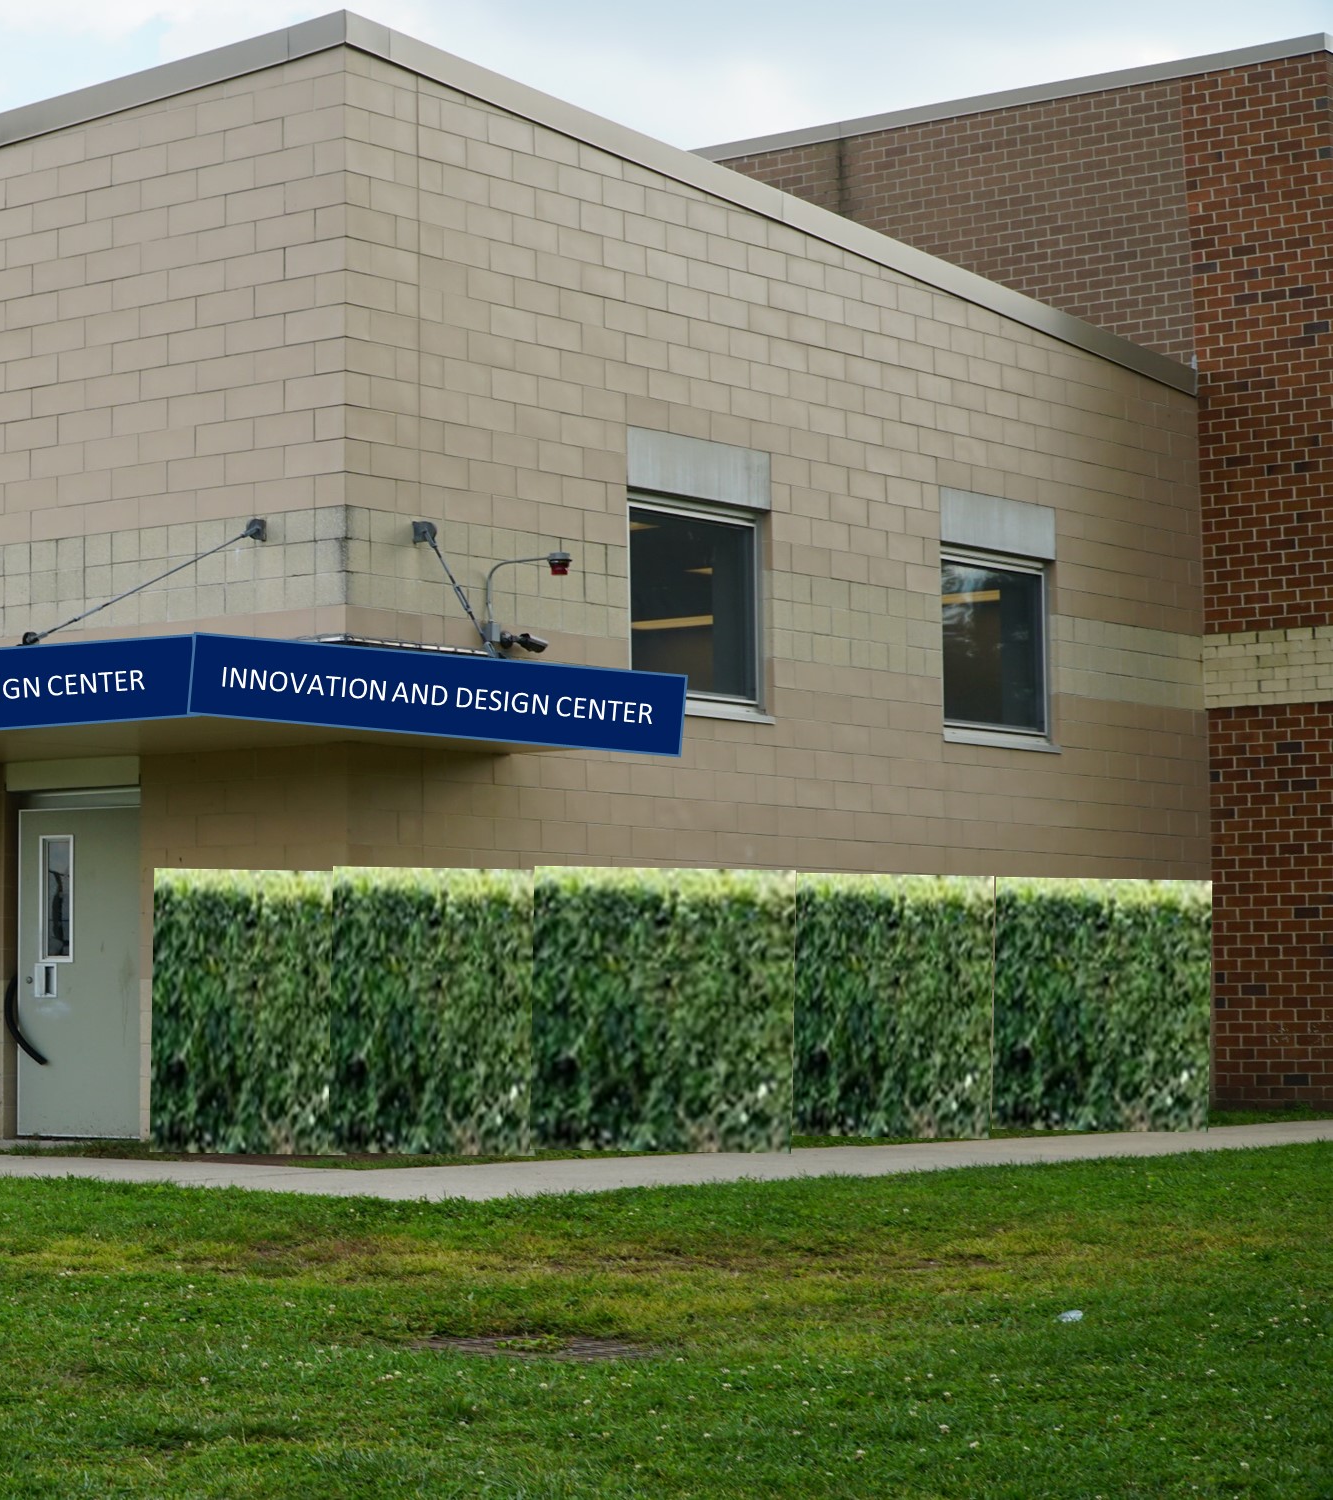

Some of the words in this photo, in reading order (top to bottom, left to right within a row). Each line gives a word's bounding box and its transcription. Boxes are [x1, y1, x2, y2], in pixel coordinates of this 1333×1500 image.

[47, 669, 146, 697] CENTER
[221, 666, 387, 702] INNOVATION
[391, 681, 448, 706] AND
[456, 687, 549, 716] DESIGN
[556, 696, 653, 725] CENTER
